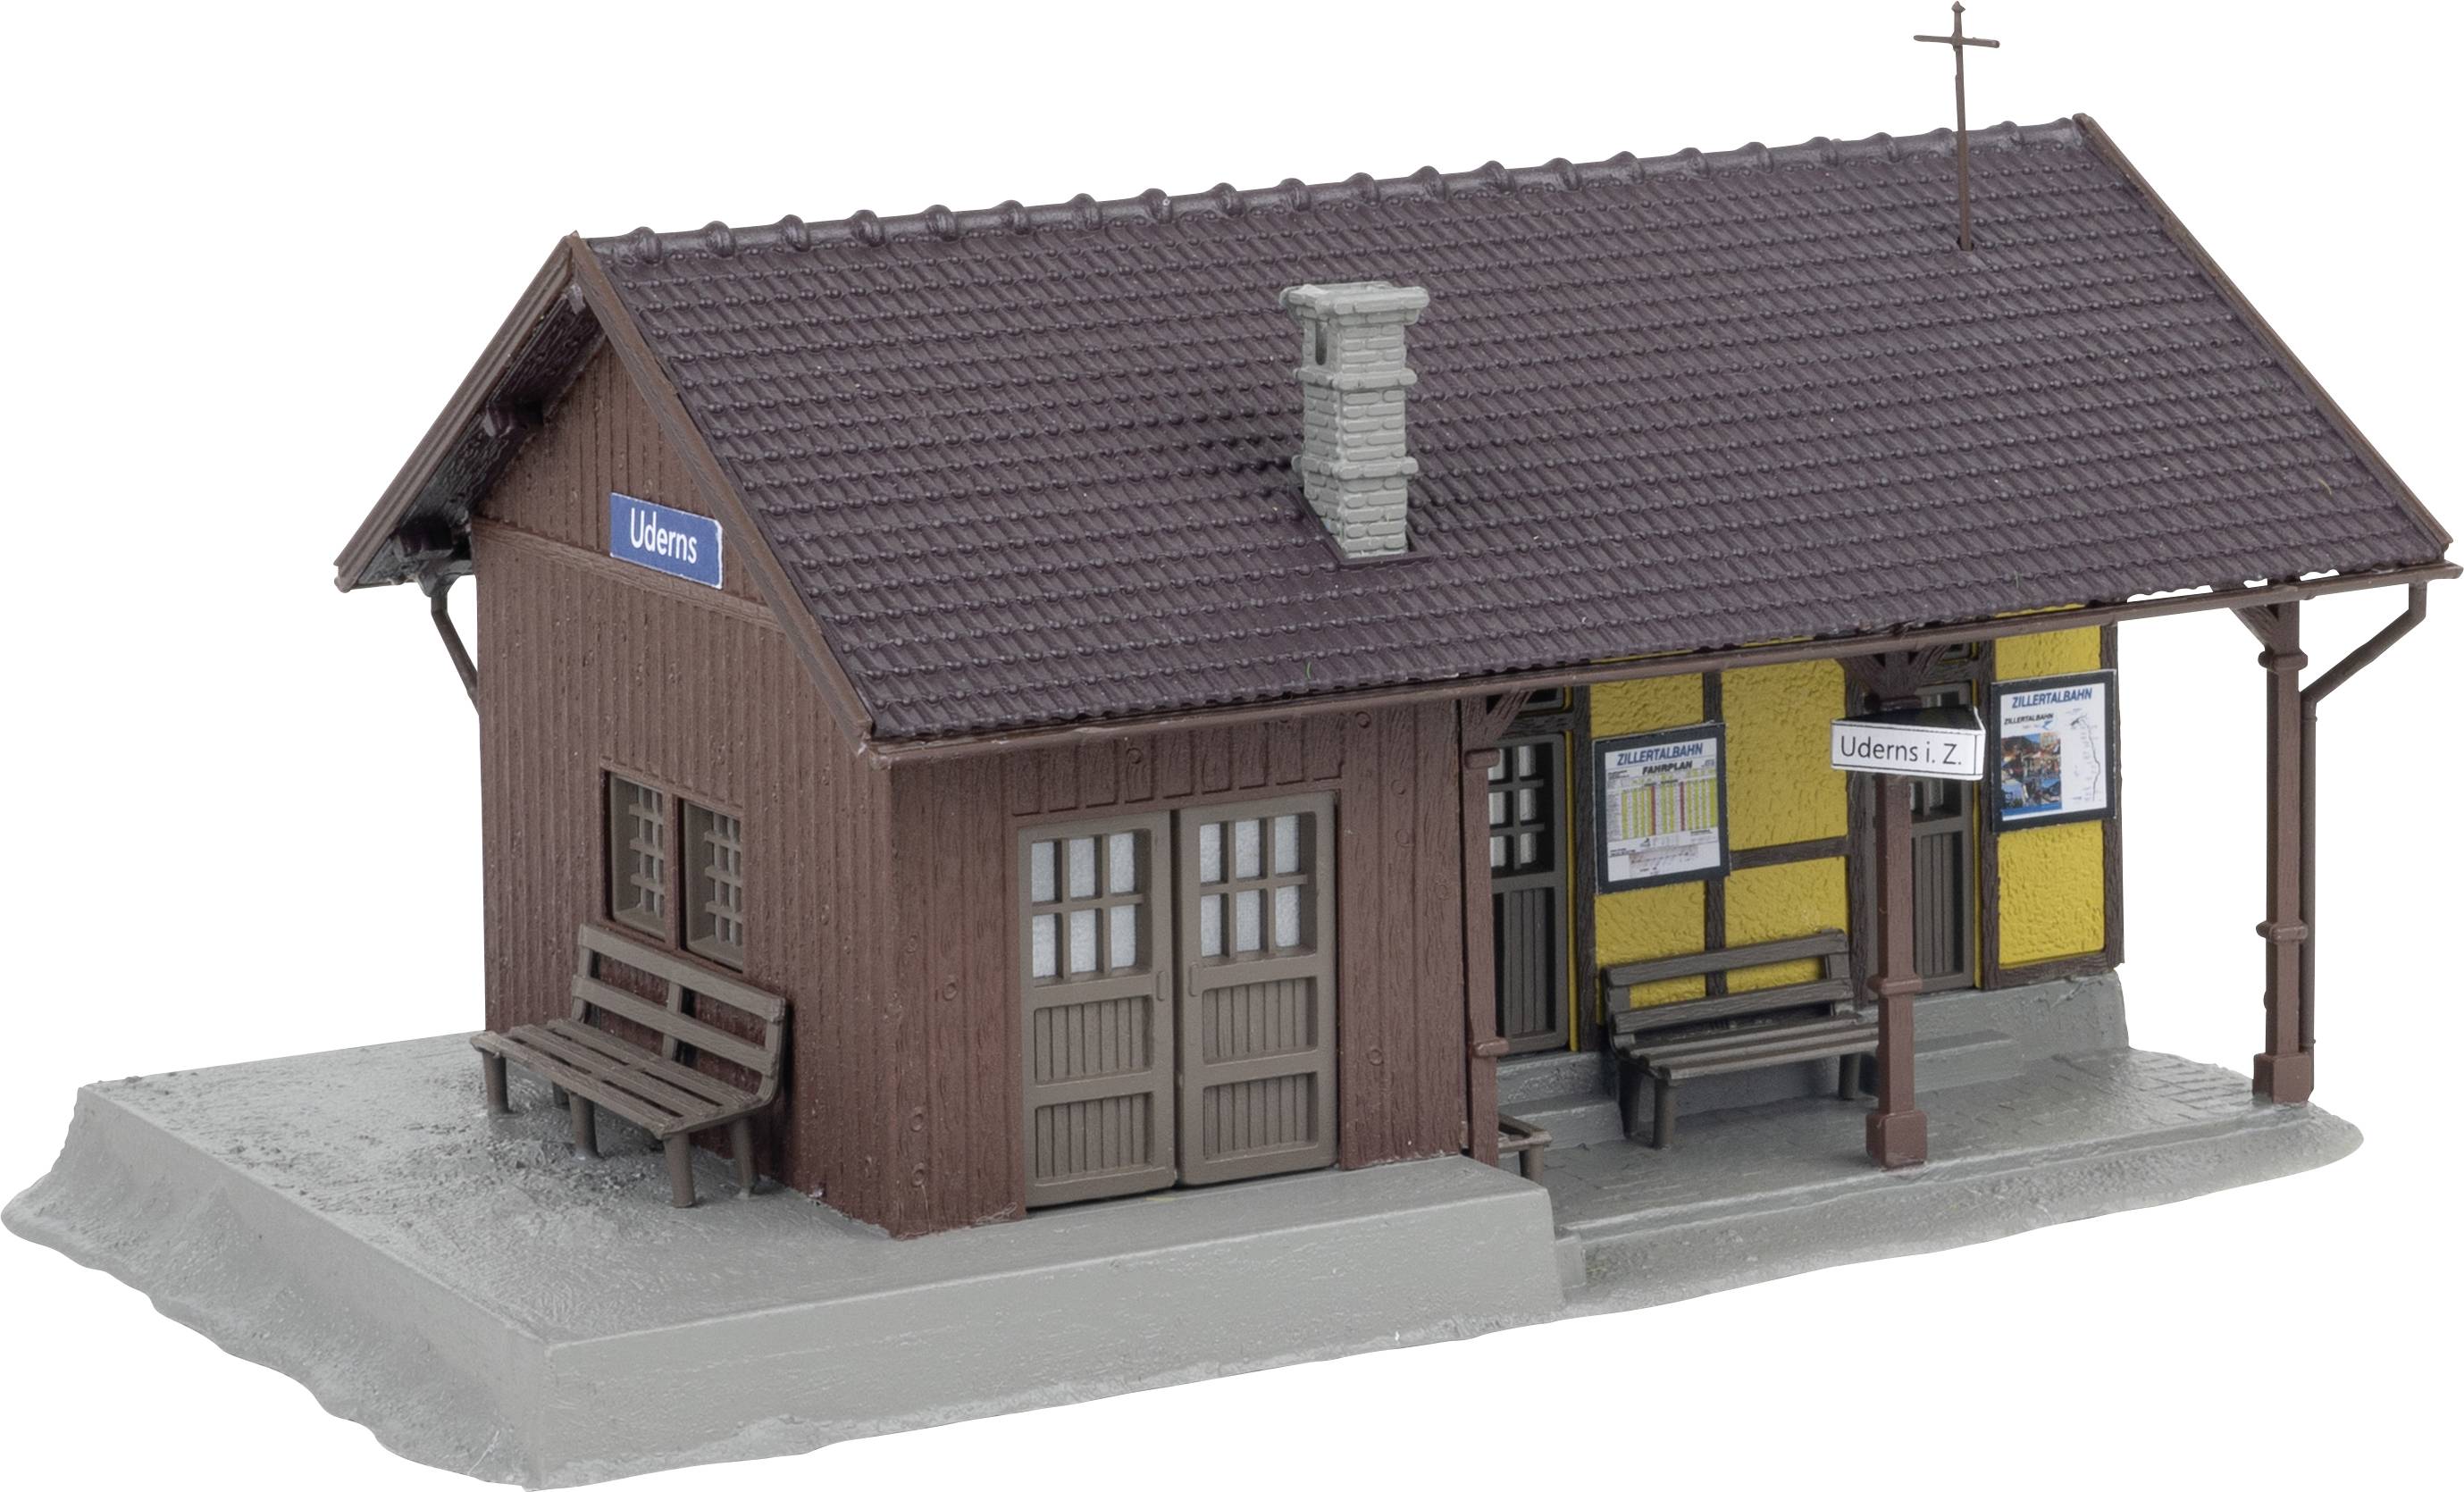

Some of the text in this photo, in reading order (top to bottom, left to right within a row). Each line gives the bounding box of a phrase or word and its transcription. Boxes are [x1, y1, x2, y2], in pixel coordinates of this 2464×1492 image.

[630, 507, 698, 565] Uderns
[2011, 687, 2093, 709] ZILLERTALBAHN
[2003, 713, 2055, 726] ZILLERTALBAHN
[1616, 742, 1704, 767] ZILLERTALBAHN
[1840, 735, 1962, 766] Uderns i. Z.
[1642, 760, 1693, 775] FAHRPLAN
